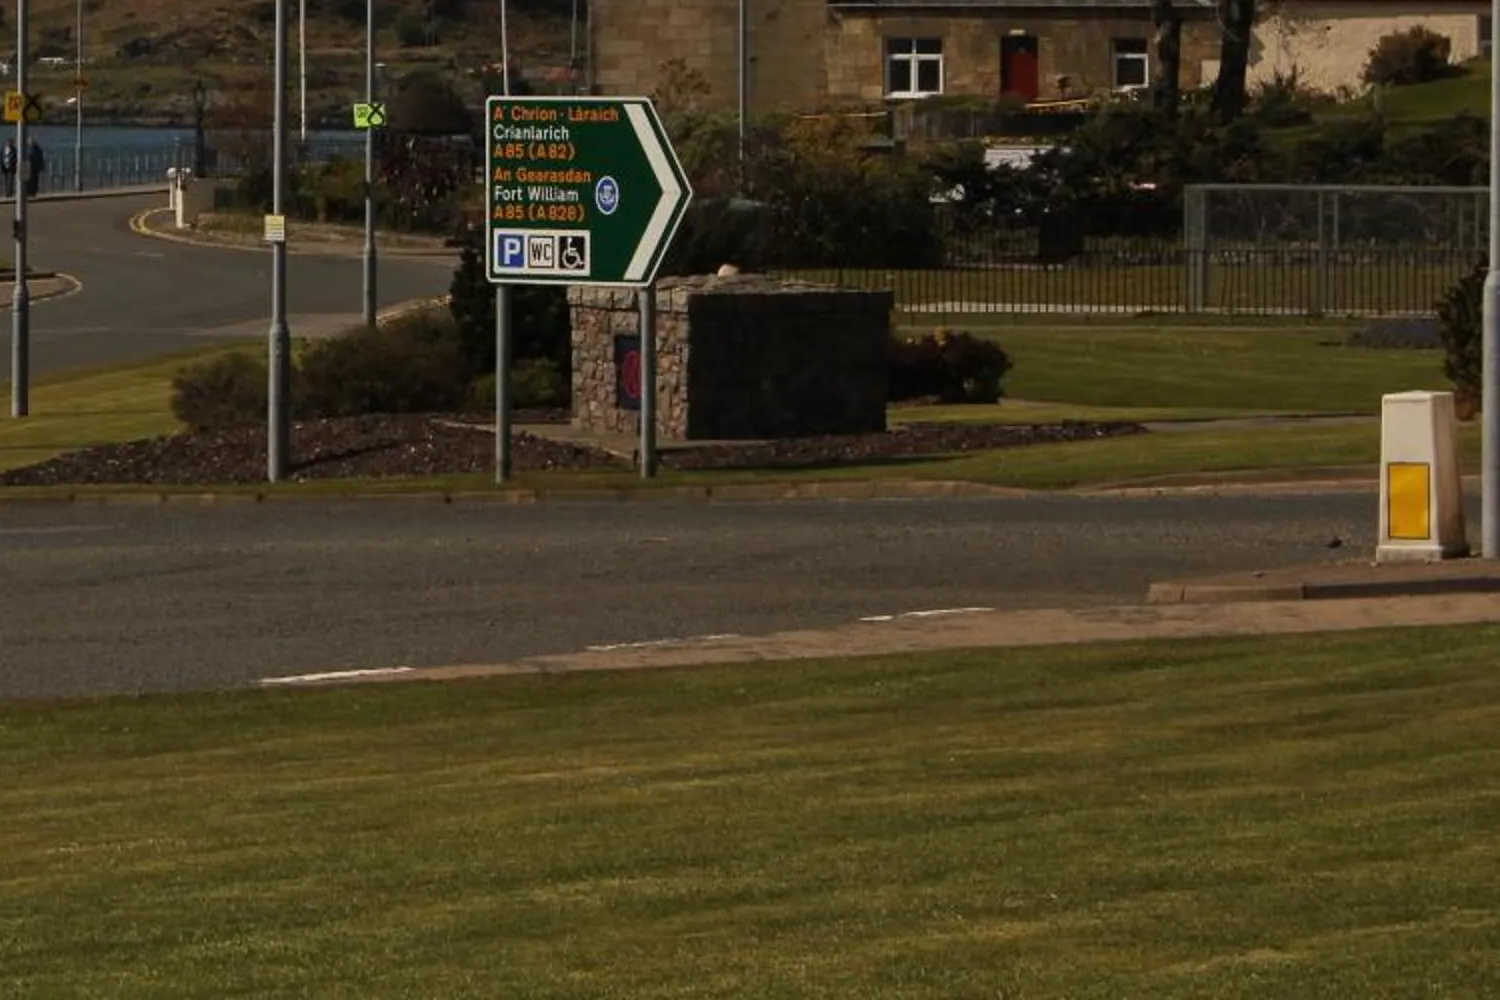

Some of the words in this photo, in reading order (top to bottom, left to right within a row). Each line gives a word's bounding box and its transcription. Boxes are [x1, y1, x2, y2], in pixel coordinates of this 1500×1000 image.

[493, 124, 569, 140] Crianlarich
[493, 143, 525, 160] A85
[528, 142, 575, 161] (A82)
[493, 167, 511, 182] An
[494, 185, 523, 201] Fort
[528, 185, 579, 202] William
[493, 204, 525, 220] A85
[528, 203, 585, 222] (A828)
[504, 238, 520, 264] P
[531, 243, 551, 261] WC
